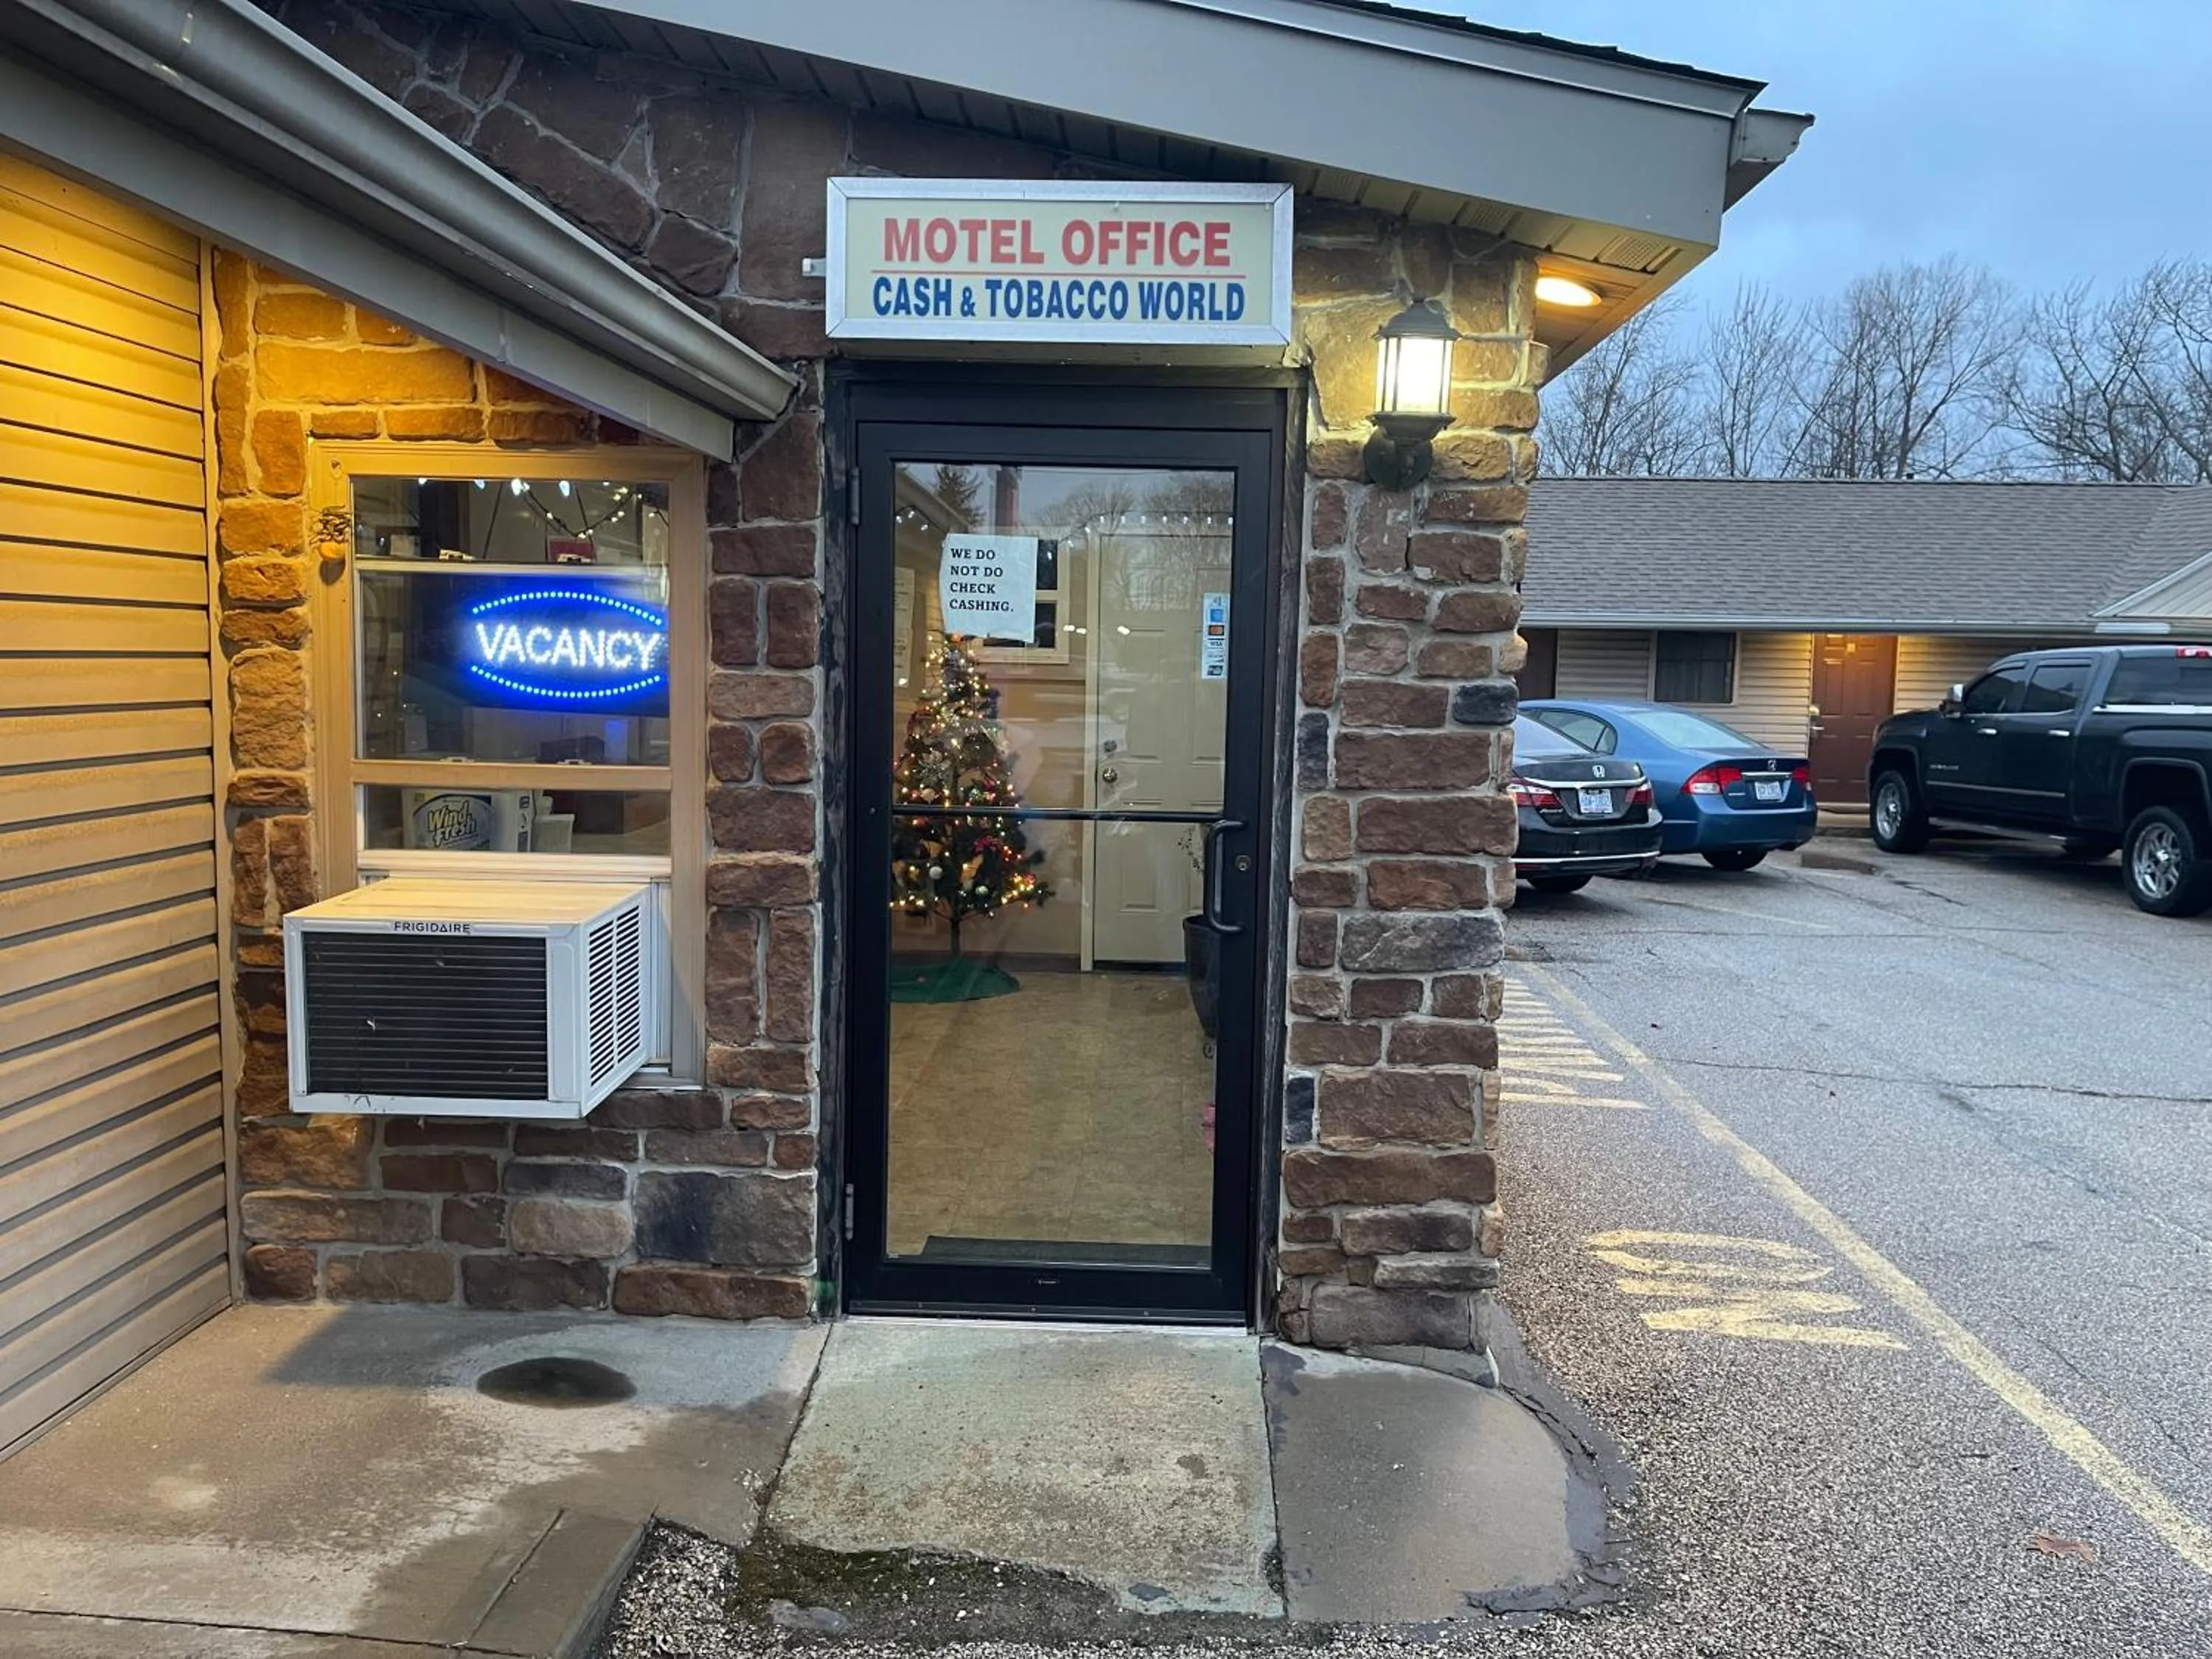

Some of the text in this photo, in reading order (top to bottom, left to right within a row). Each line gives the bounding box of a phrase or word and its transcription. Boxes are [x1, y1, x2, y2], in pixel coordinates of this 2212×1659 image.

[883, 218, 1231, 267] MOTEL OFFICE
[872, 276, 1246, 322] CASH & TOBACCO WORLD
[950, 548, 996, 560] WE DO
[950, 566, 1004, 577] NOT DO
[949, 582, 996, 594] CHECK
[949, 598, 1015, 613] CASHING.
[476, 622, 661, 671] VACANCY
[428, 800, 470, 832] Wind
[434, 813, 478, 848] Fresh
[394, 921, 471, 934] FRIGIDAIRE
